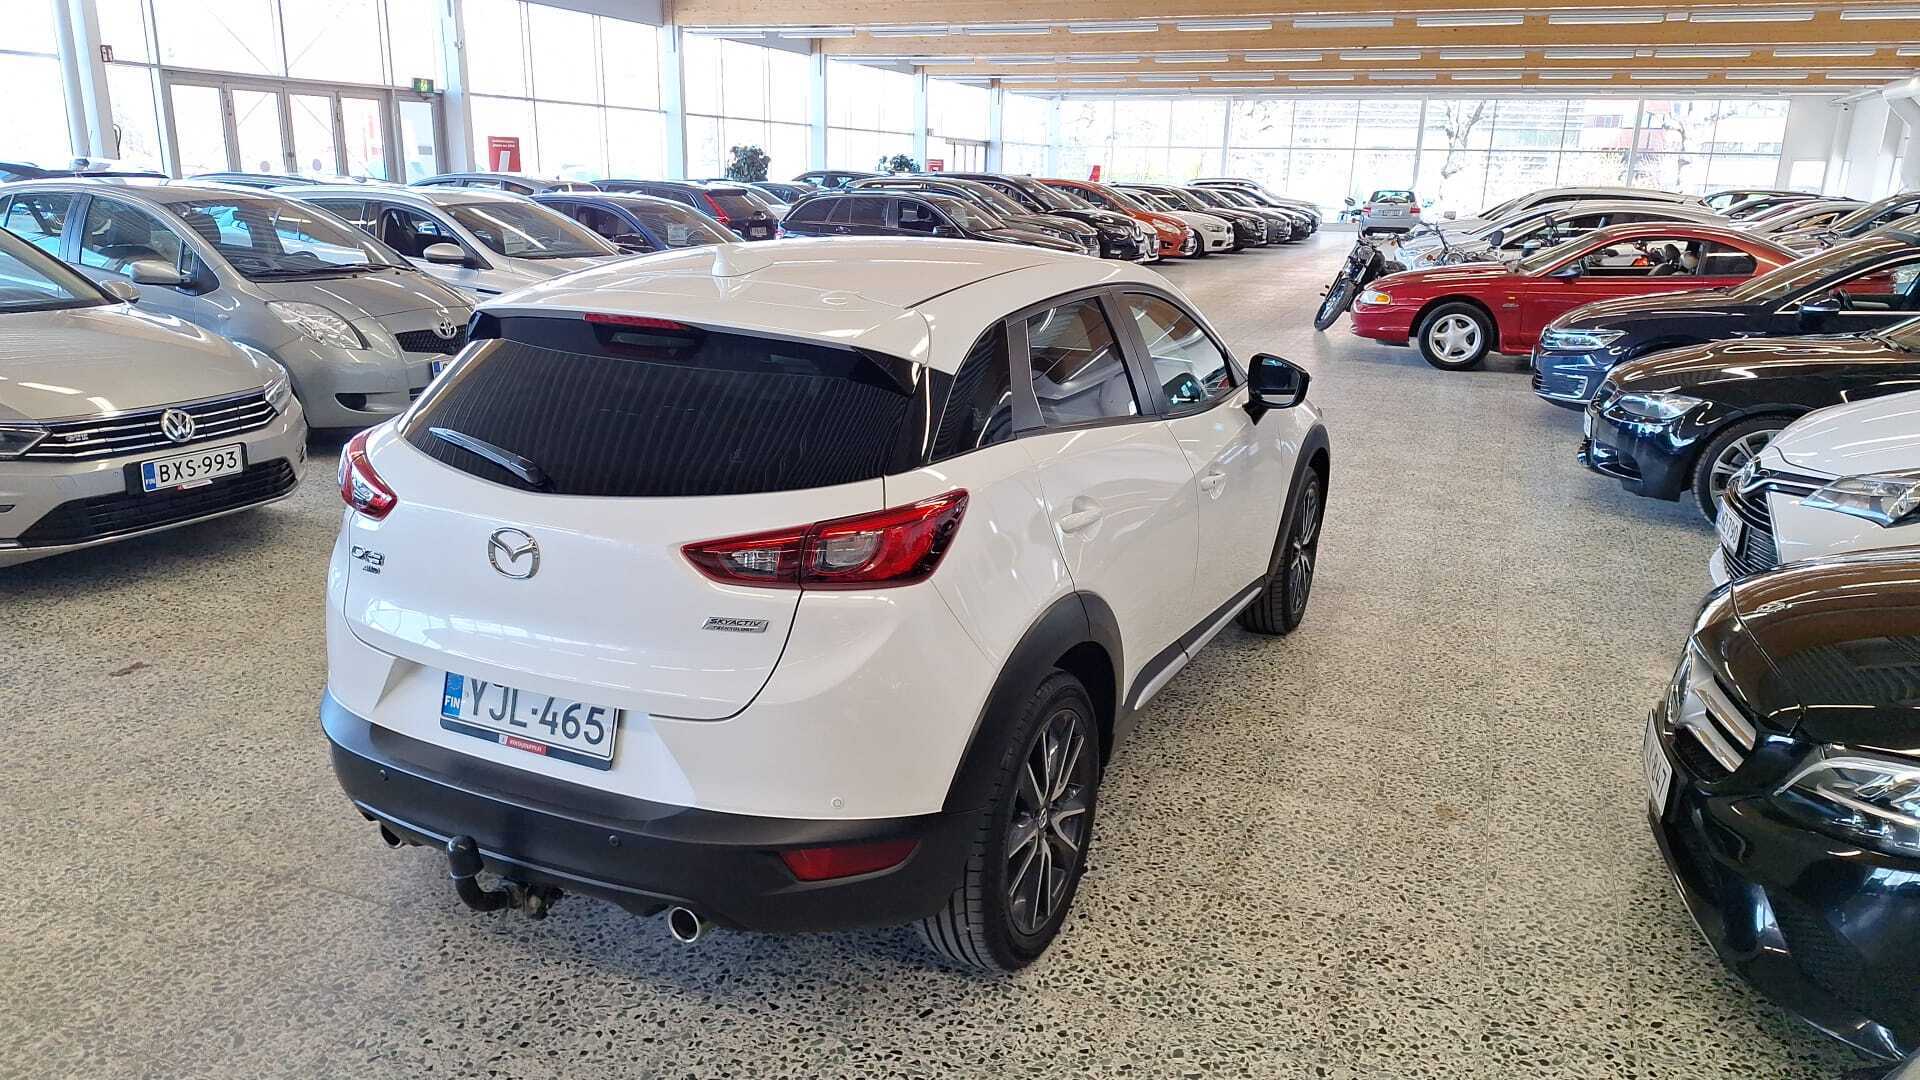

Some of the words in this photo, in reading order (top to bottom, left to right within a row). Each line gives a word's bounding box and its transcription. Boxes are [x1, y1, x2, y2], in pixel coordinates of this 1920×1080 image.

[159, 451, 237, 483] BXS-993
[708, 618, 762, 627] SKYACTIV
[444, 697, 461, 709] FIN
[471, 678, 605, 745] YJL-465
